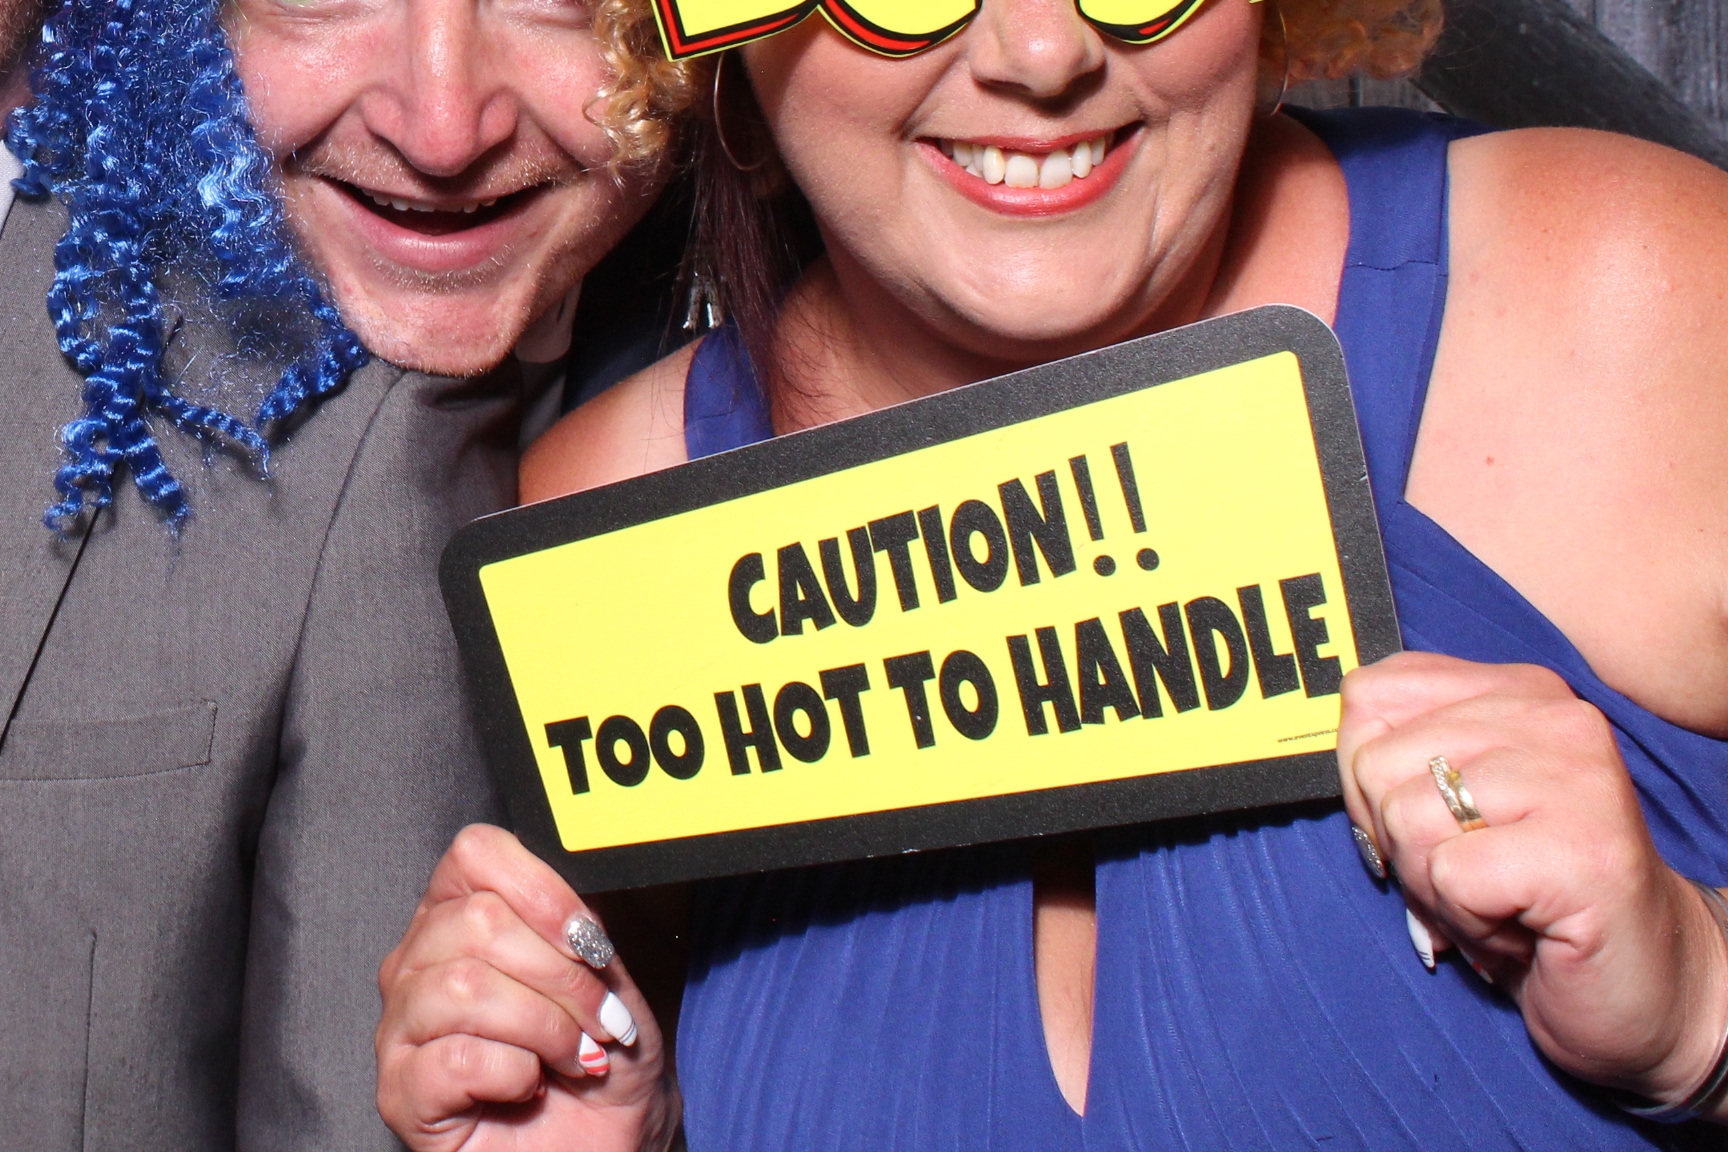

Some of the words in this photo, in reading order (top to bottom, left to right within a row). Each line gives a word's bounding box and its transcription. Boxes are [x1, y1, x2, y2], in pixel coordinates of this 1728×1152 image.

[728, 442, 1161, 645] CAUTION!!
[545, 715, 705, 796] TOO
[714, 663, 871, 776] HOT
[884, 649, 999, 750] TO
[1008, 572, 1345, 737] HANDLE
